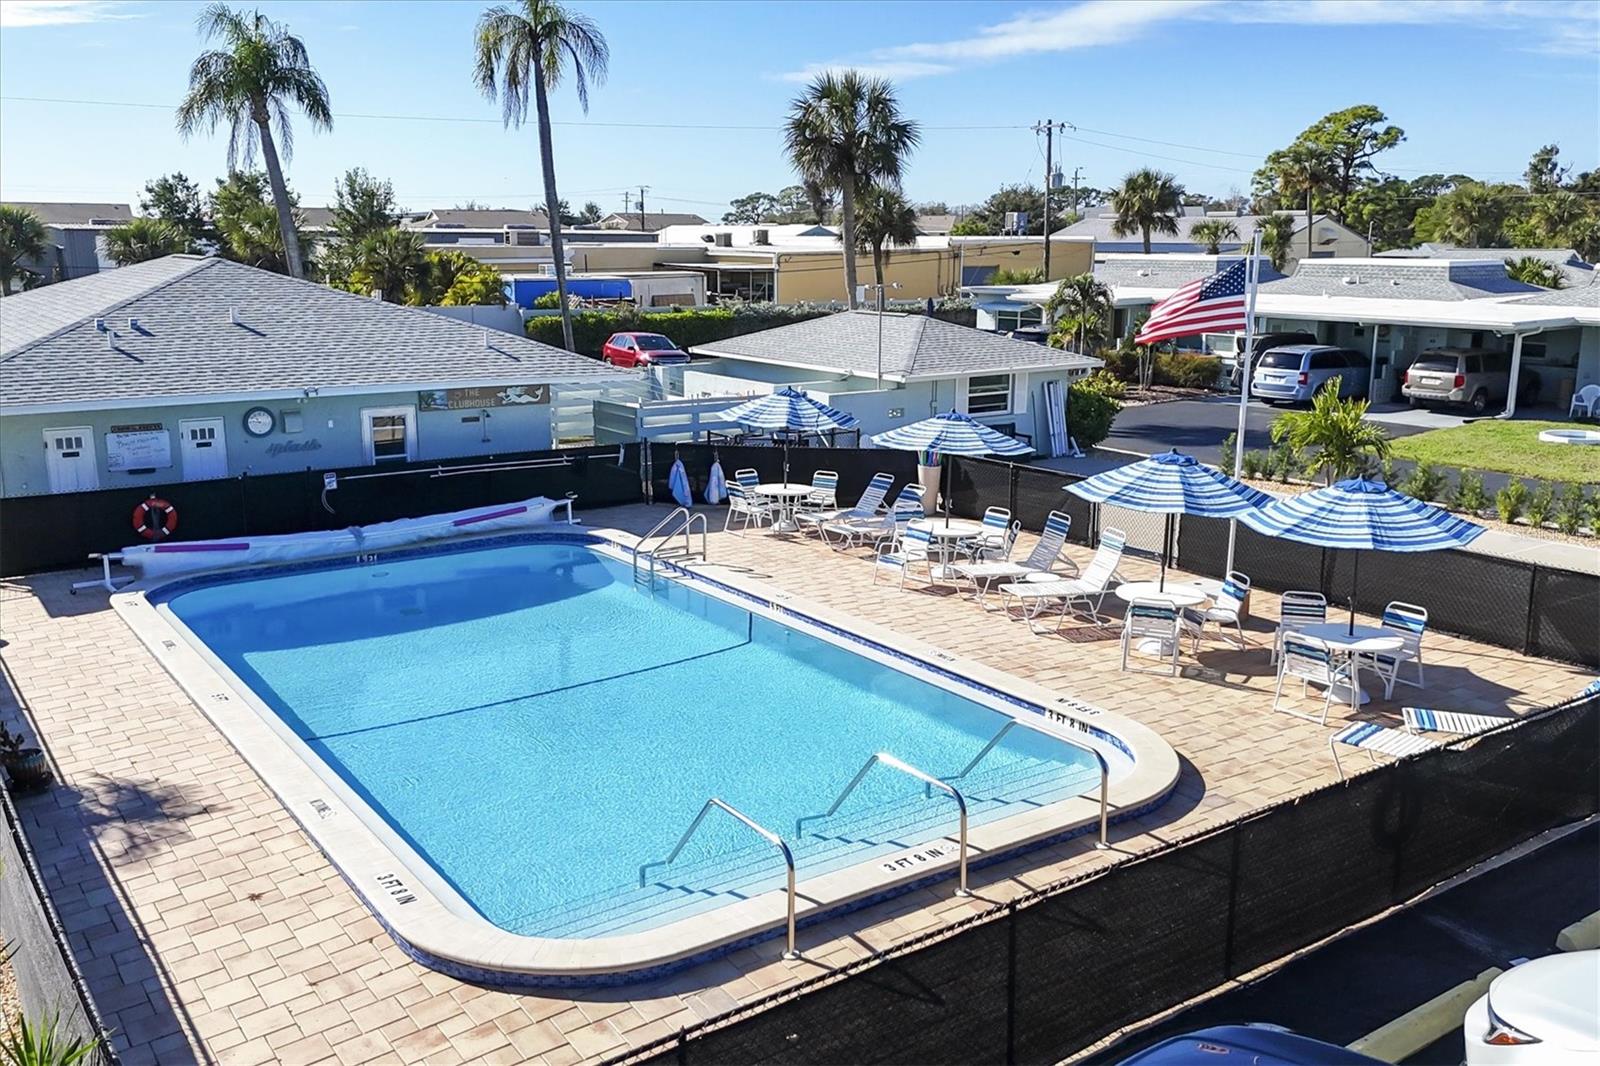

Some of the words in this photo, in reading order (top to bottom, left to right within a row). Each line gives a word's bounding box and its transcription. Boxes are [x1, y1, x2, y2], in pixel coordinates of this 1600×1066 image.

[464, 388, 481, 398] THE
[448, 399, 496, 409] CLUBHOUSE
[1056, 713, 1067, 725] FT
[1078, 721, 1089, 733] IN
[884, 863, 896, 872] 3
[895, 857, 914, 868] FT
[913, 853, 927, 862] 8
[925, 848, 945, 858] IN
[377, 873, 394, 881] 3
[381, 879, 403, 889] FT
[395, 893, 418, 905] IN
